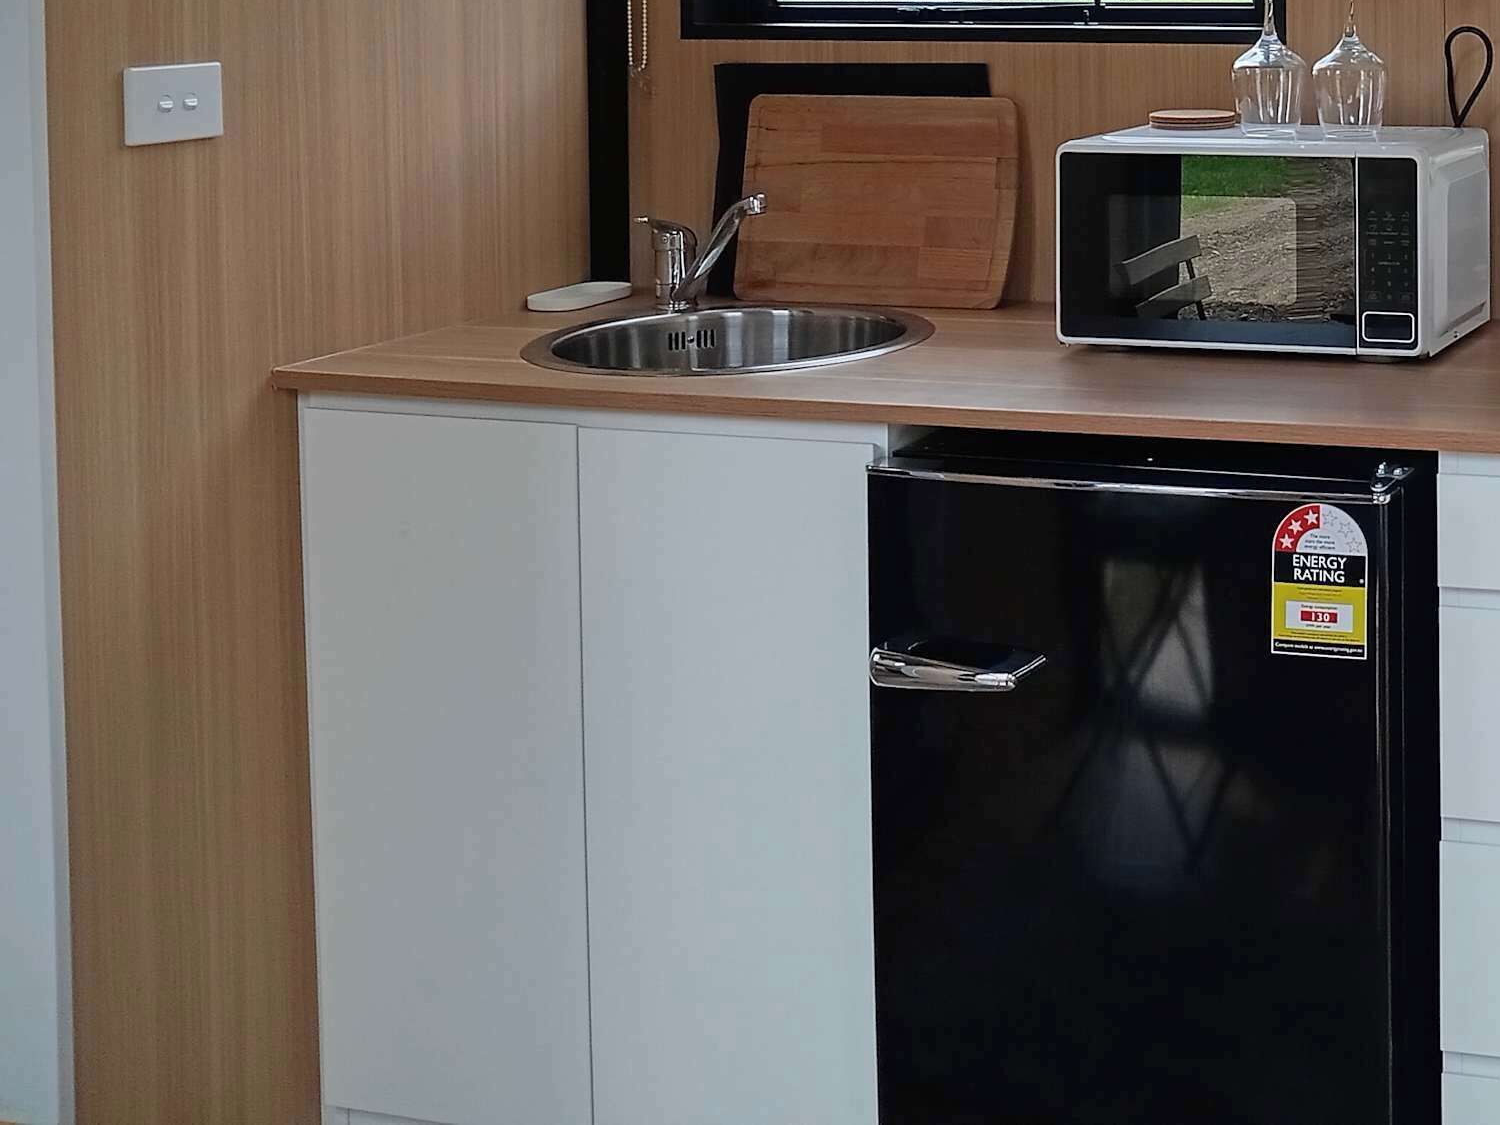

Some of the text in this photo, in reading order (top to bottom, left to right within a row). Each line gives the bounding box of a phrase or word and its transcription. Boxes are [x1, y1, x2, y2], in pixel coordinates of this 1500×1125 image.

[1292, 554, 1347, 569] ENERGY
[1293, 568, 1345, 583] RATING
[1311, 612, 1330, 622] 130
